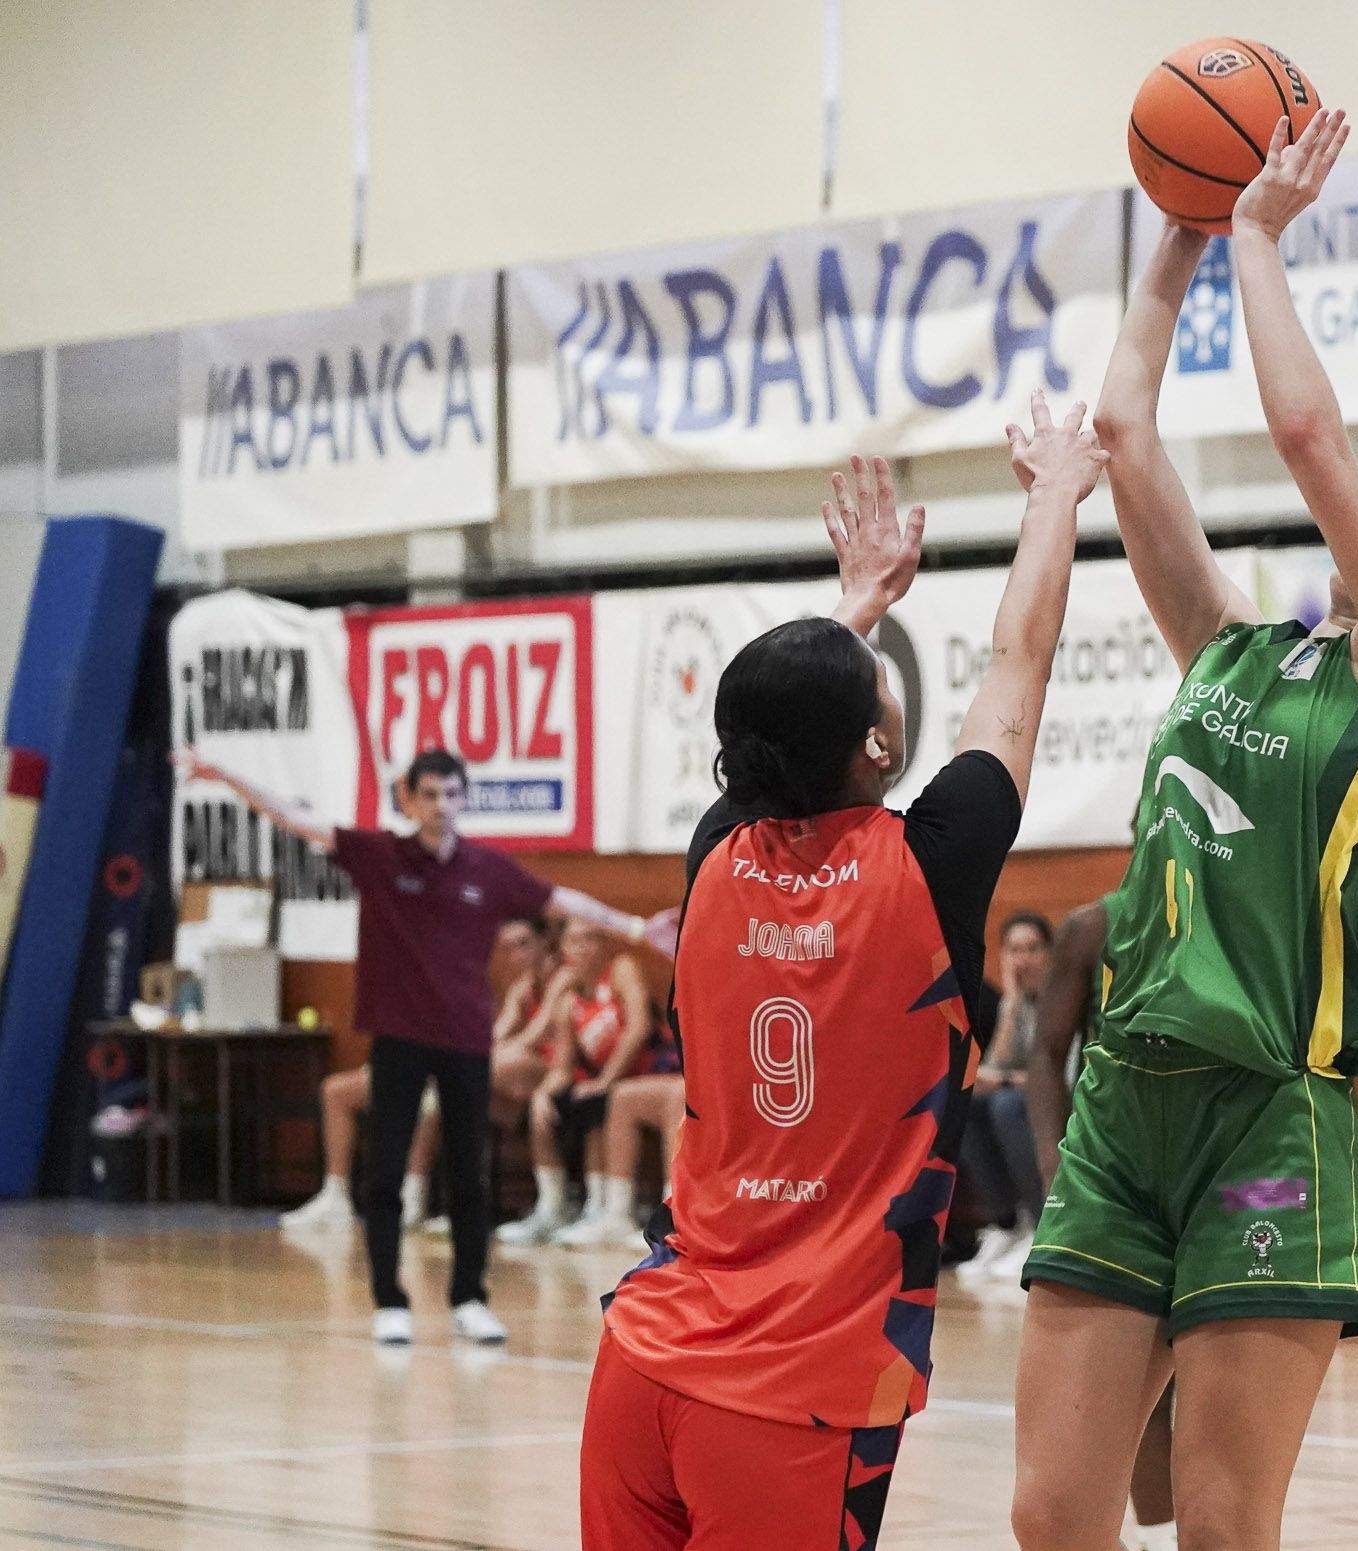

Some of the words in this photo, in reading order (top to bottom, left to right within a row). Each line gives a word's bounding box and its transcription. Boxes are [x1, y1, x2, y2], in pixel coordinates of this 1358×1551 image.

[598, 221, 1070, 441] ABANCA
[227, 332, 483, 474] ABANCA
[381, 639, 562, 764] FROIZ
[1201, 710, 1290, 759] GALICIA
[733, 857, 859, 893] TALENOM
[738, 918, 835, 961] JOANA
[751, 996, 815, 1128] 9
[736, 1175, 828, 1203] MATARÓ
[1250, 1220, 1283, 1246] BALONCESTO
[1247, 1268, 1275, 1278] ARXIL
